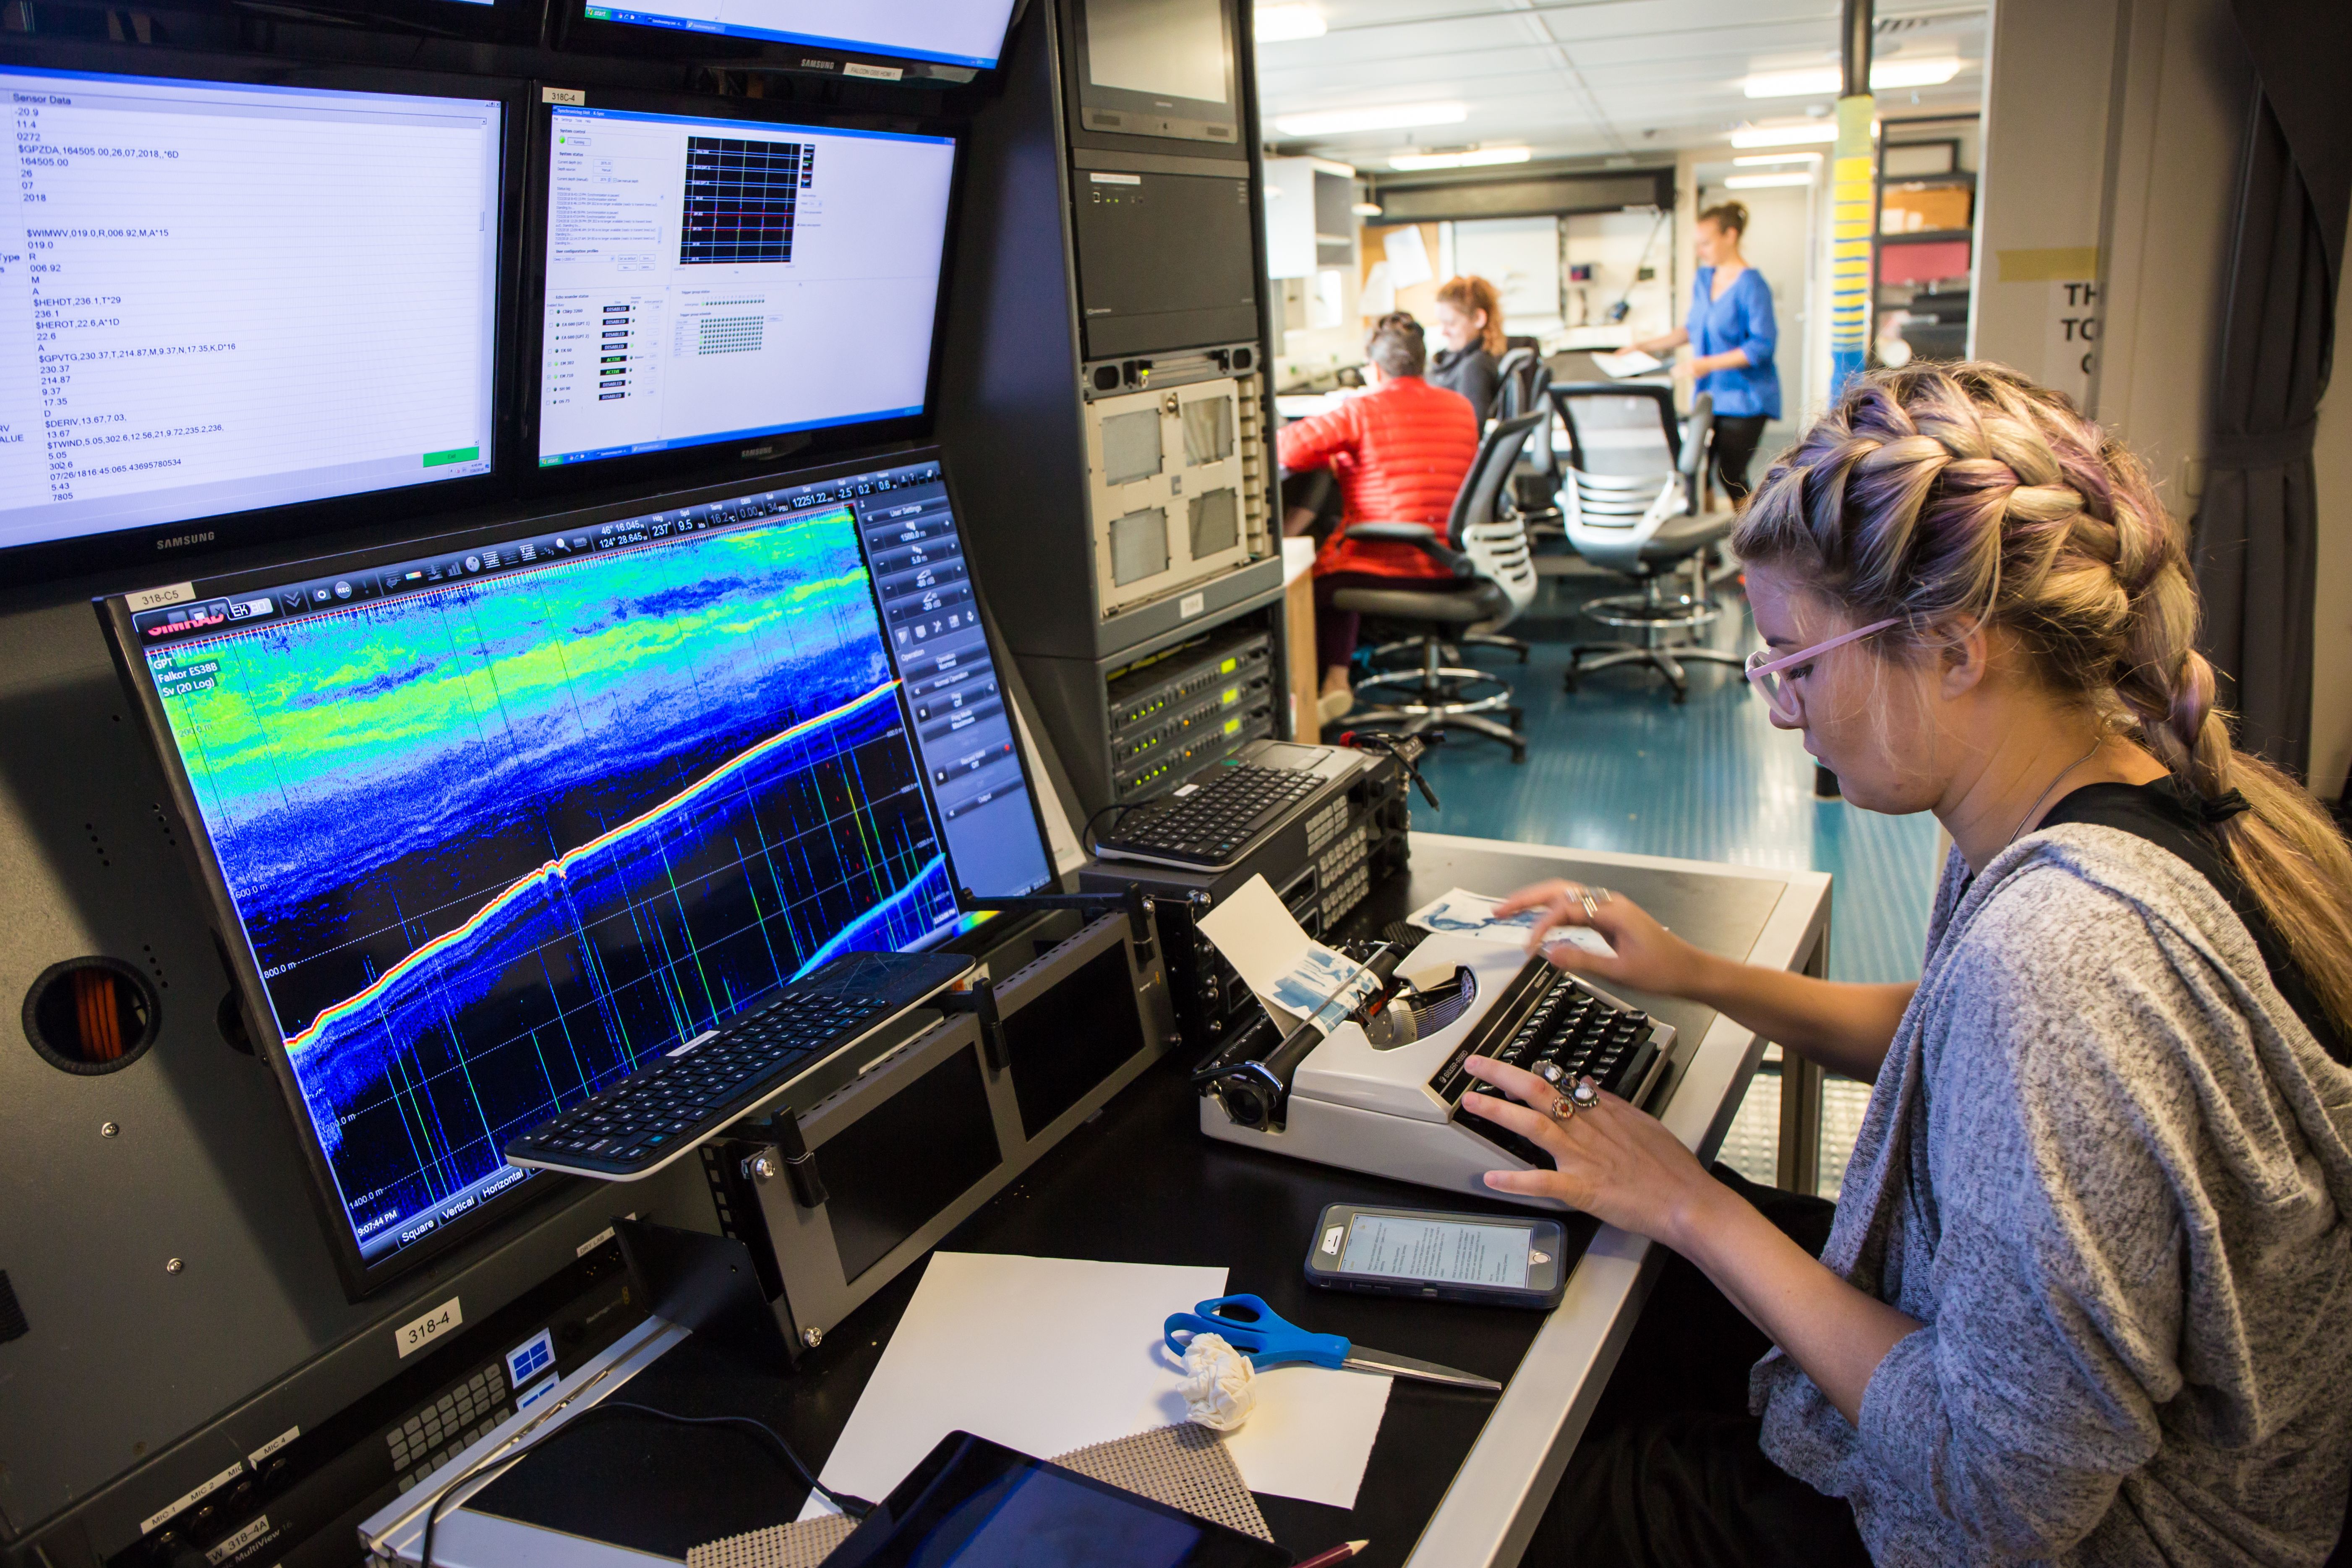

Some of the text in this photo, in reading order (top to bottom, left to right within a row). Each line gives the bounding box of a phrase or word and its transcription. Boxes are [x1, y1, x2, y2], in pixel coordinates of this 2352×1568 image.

[801, 59, 834, 69] SAMSUNG
[13, 93, 71, 105] Sensor Data
[552, 92, 575, 102] 318C-4
[16, 120, 36, 129] 11.4
[17, 132, 40, 141] 0272
[20, 157, 68, 166] 164505.00
[23, 193, 46, 202] 2018
[30, 264, 61, 272] 006.92
[37, 332, 56, 341] 22.6
[40, 365, 69, 374] 230.37
[41, 376, 70, 385] 214.87
[42, 387, 60, 396] 9.37
[44, 398, 68, 407] 17.35
[47, 430, 70, 438] 13.67
[48, 451, 67, 460] 5.05
[742, 447, 772, 457] SAMSUNG
[51, 483, 69, 491] 5.43
[879, 480, 890, 490] 0.6
[52, 493, 73, 501] 7805
[793, 493, 827, 508] 12251.22
[740, 506, 758, 518] 0.00
[903, 505, 922, 514] Settings
[711, 512, 728, 524] 16.2
[678, 519, 692, 531] 9.5
[157, 532, 214, 549] SAMSUNG
[901, 530, 919, 542] 1500.0
[911, 556, 921, 564] 5.0
[142, 591, 179, 605] 318-C5
[901, 650, 924, 662] Operation
[153, 659, 173, 670] GPT
[938, 659, 956, 671] Normal
[158, 662, 218, 684] Falkor ES38B
[935, 671, 968, 688] Normal Operation
[162, 677, 215, 697] Sv (20 Log)
[952, 716, 975, 730] Maximum
[971, 760, 979, 769] Off
[235, 885, 258, 899] 600.0
[264, 964, 287, 979] 800.0
[349, 1190, 373, 1209] 1400.0
[401, 1169, 524, 1242] Square Vertical Horizontal
[357, 1209, 398, 1237] 9:07:44 PM
[408, 1312, 450, 1344] 318-4
[264, 1441, 279, 1455] MIC
[152, 1510, 169, 1526] MIC
[191, 1485, 208, 1501] MIC
[211, 1521, 266, 1561] W 318-4A
[235, 1529, 279, 1563] MultiView
